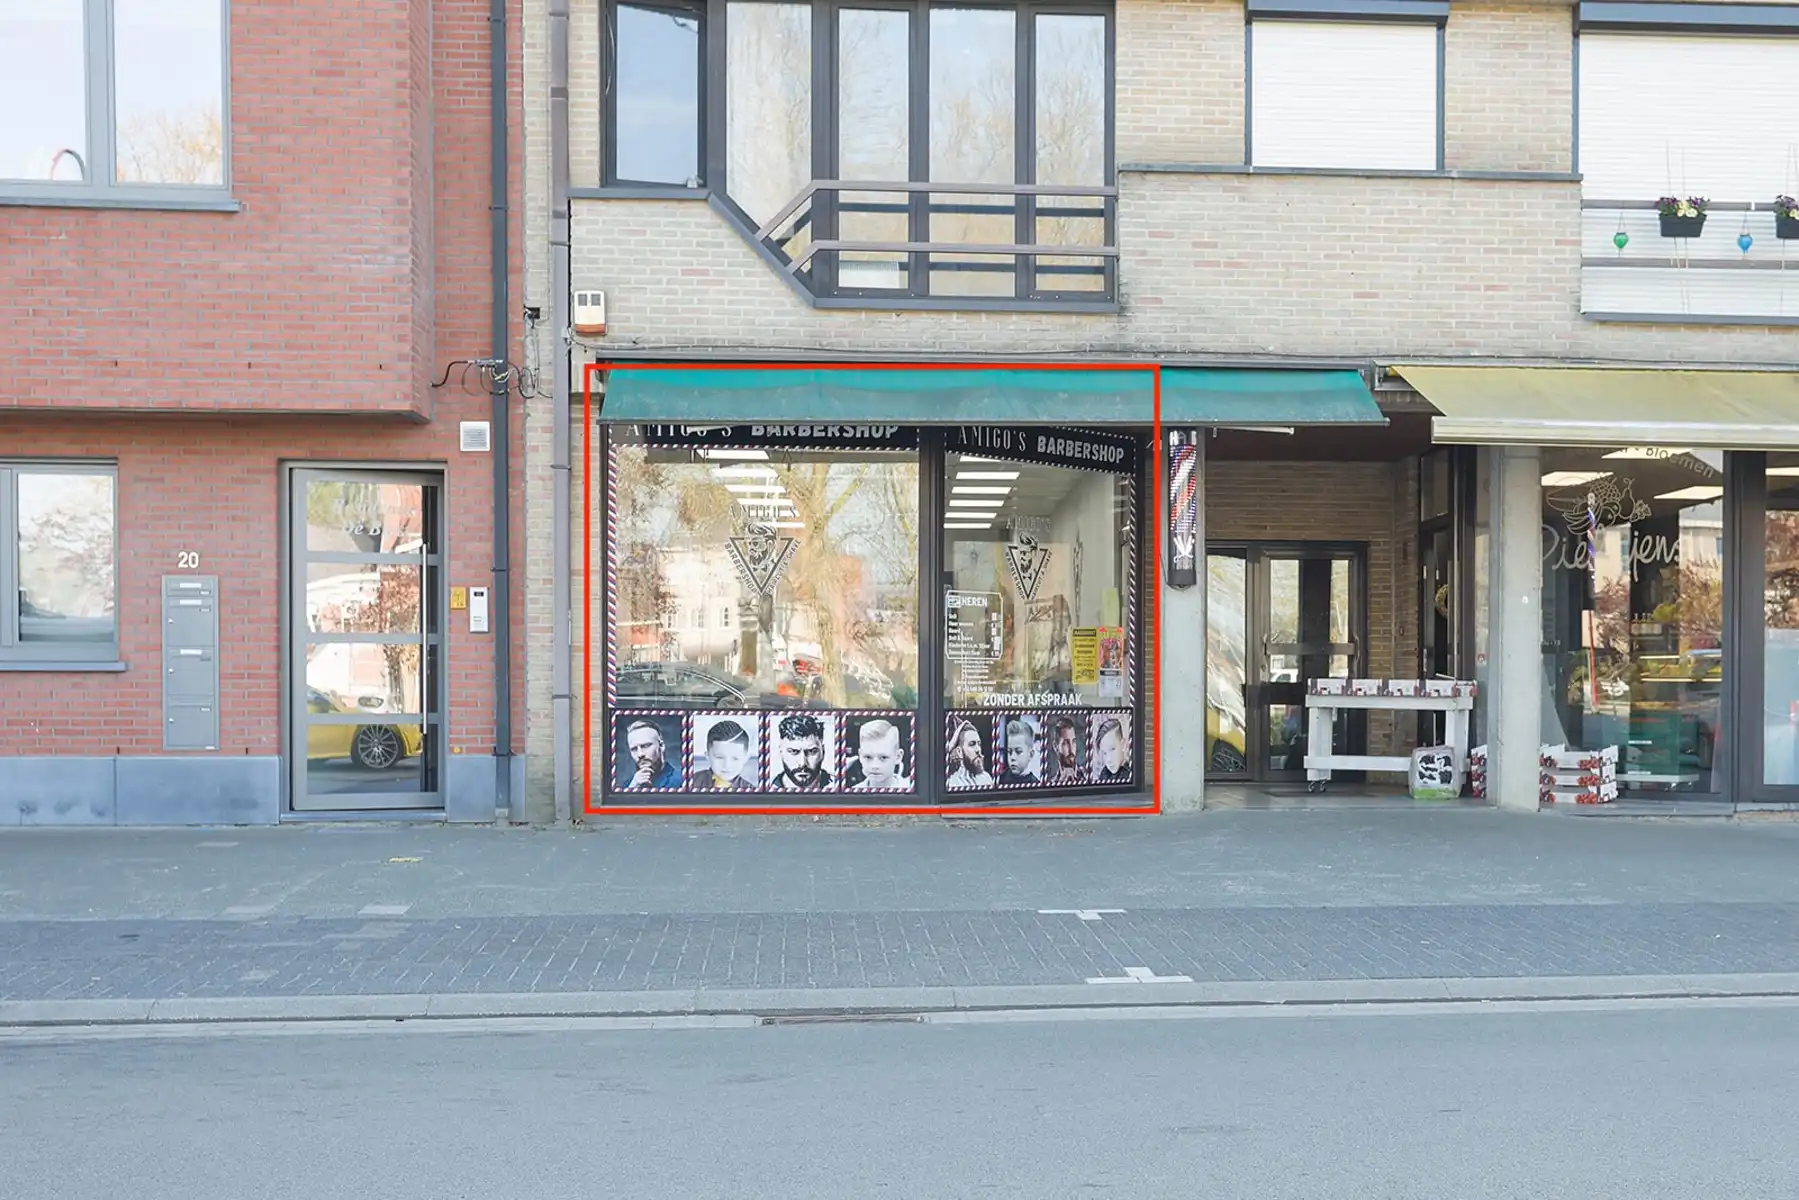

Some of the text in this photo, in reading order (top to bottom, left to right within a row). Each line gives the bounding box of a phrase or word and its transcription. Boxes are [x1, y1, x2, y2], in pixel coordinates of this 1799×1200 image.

[958, 425, 1125, 464] AMIGO'S BARBERSHOP
[1645, 447, 1714, 479] Bloemen
[178, 551, 199, 569] 20
[724, 542, 758, 594] BARBERSHOP
[1005, 551, 1026, 600] BARBERSHOP
[961, 596, 987, 607] HEREN
[983, 693, 1082, 706] ZONDER AFSPRAAK
